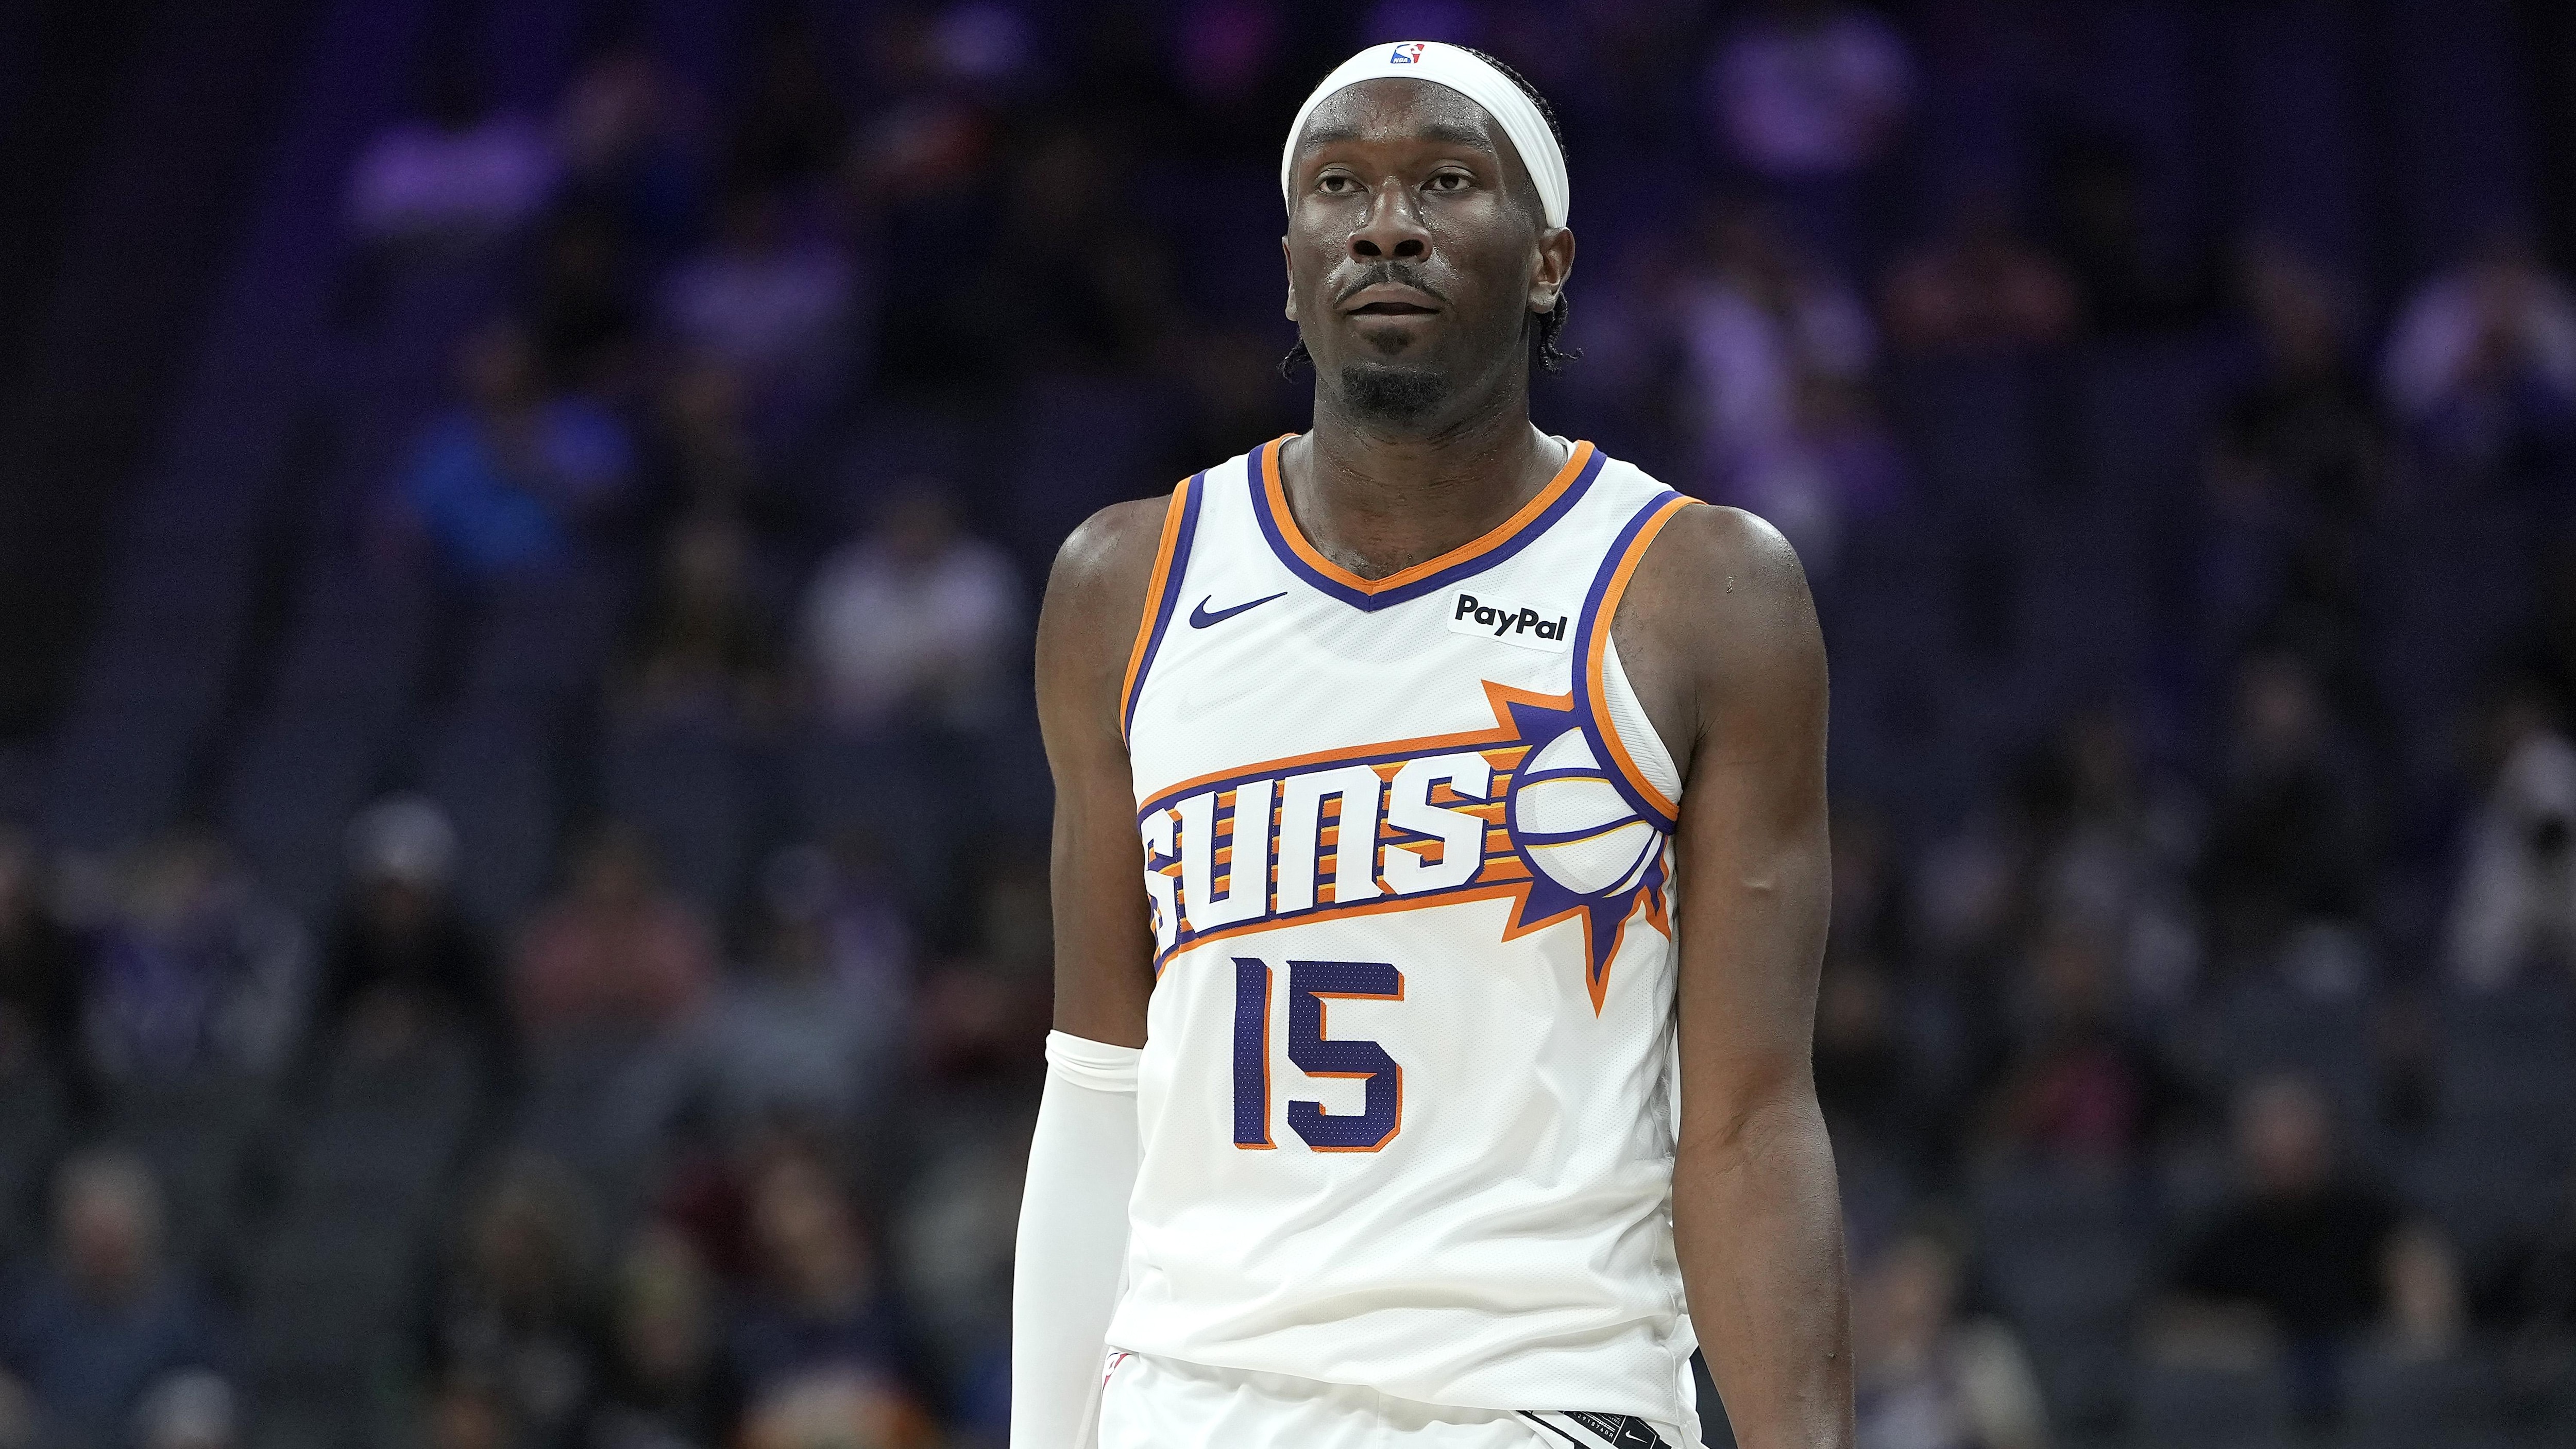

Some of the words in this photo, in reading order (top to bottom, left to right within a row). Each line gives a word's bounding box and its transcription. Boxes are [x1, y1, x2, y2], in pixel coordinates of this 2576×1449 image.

[1455, 594, 1568, 641] PayPal
[1141, 752, 1491, 956] SUNS
[1231, 958, 1404, 1152] 15
